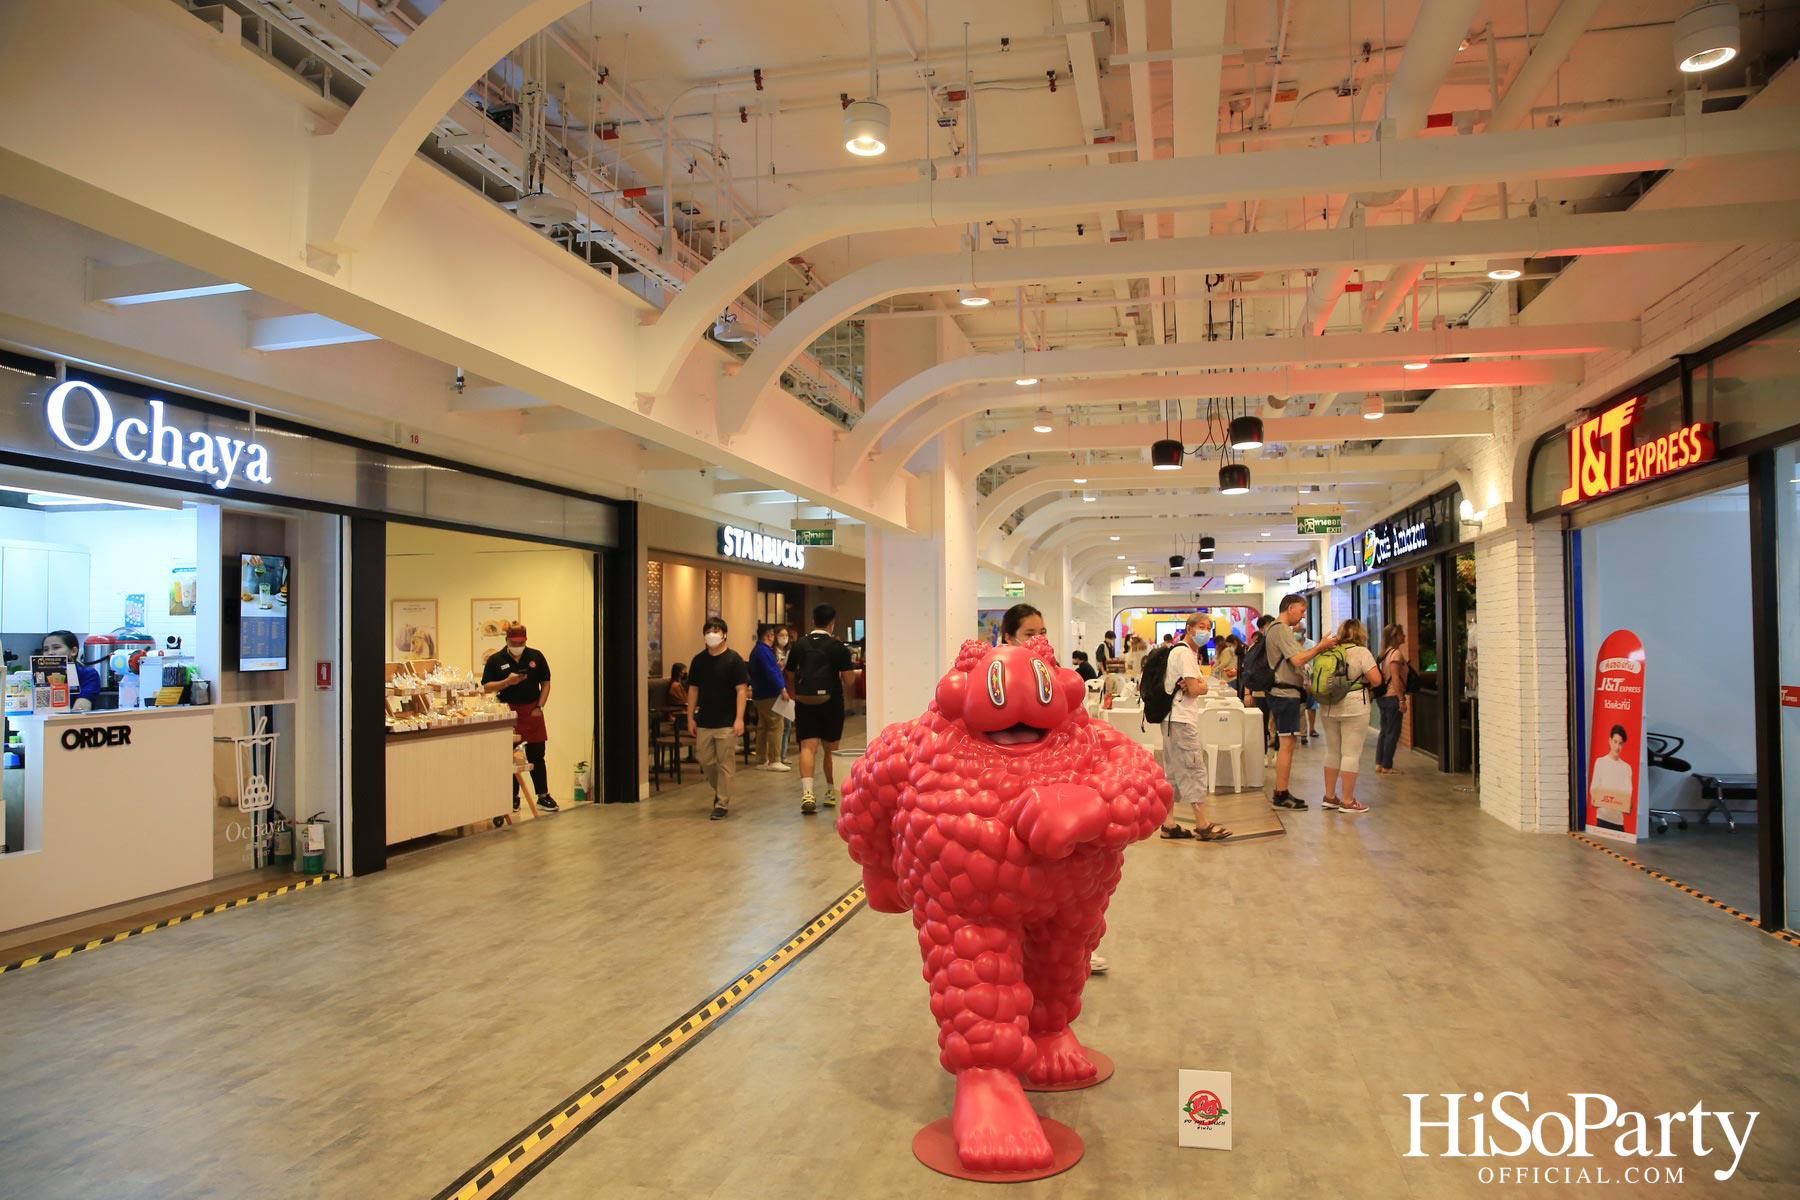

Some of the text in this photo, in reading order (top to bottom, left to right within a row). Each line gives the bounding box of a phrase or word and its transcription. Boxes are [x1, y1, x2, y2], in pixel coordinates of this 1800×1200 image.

[46, 380, 273, 490] Ochaya
[1560, 397, 1702, 507] J&T EXPRESS
[723, 525, 805, 570] STARBUCKS
[1393, 521, 1428, 558] Amazon
[1597, 677, 1626, 692] J&T
[61, 725, 131, 750] ORDER
